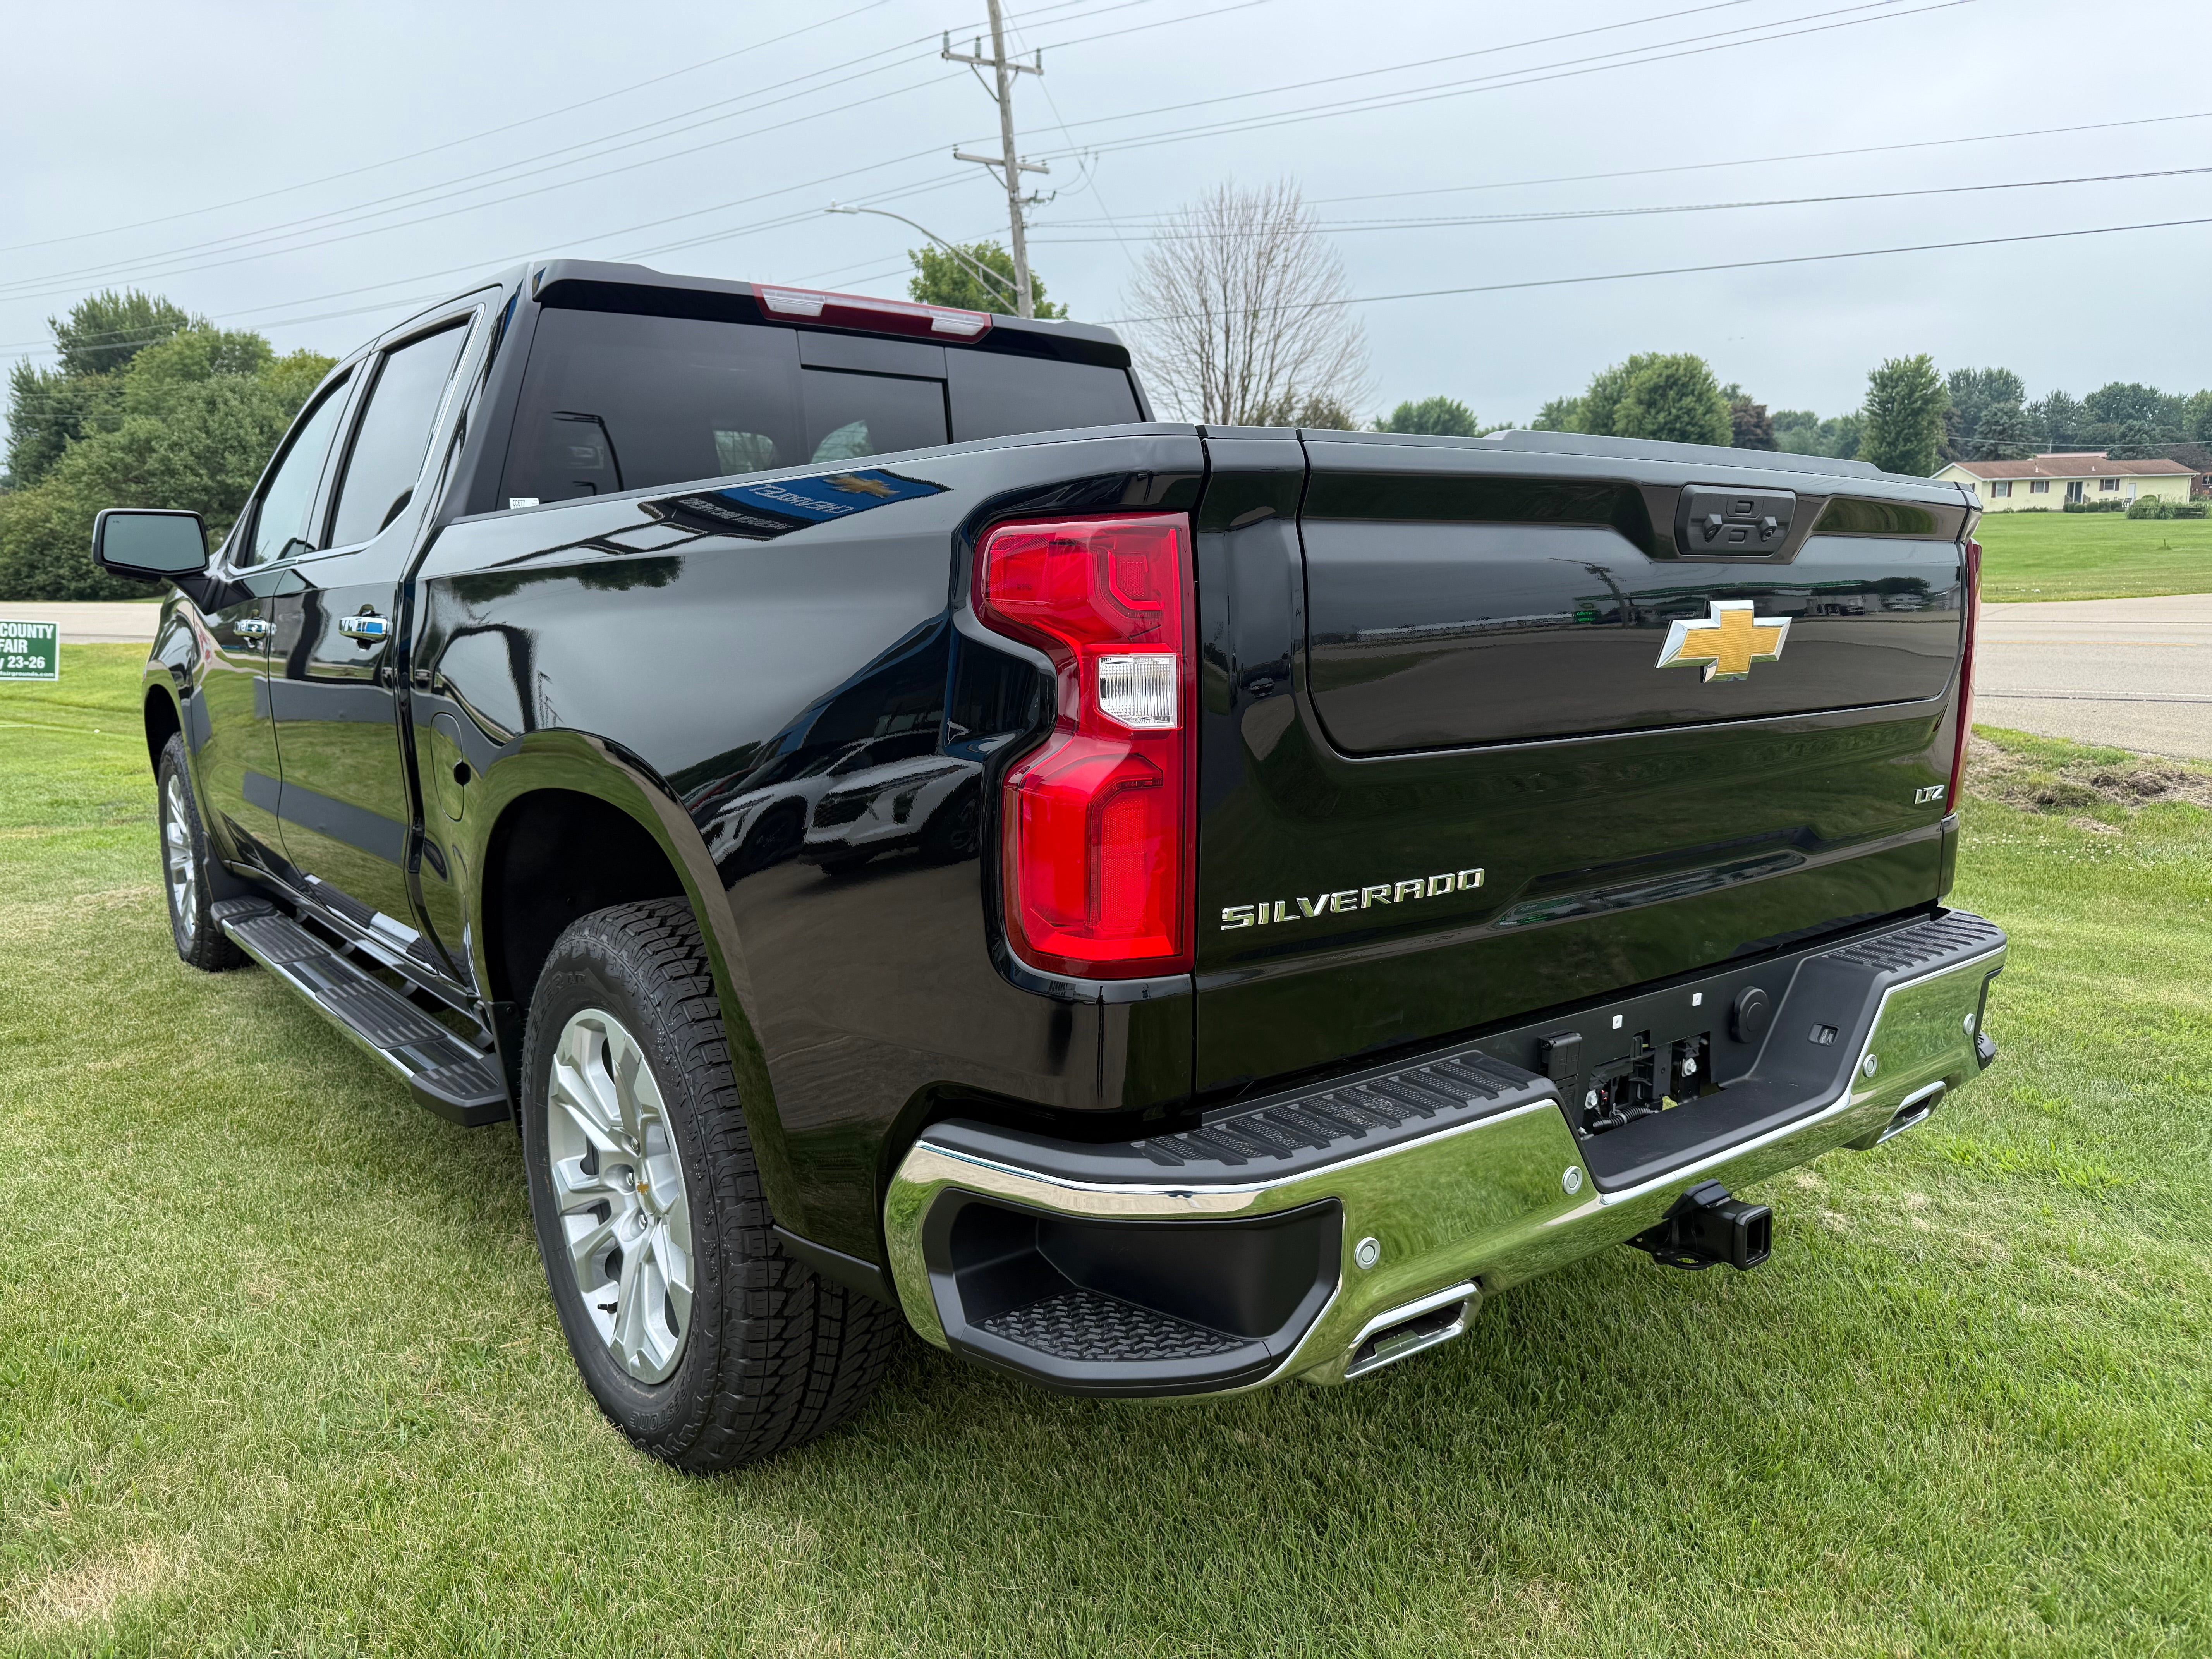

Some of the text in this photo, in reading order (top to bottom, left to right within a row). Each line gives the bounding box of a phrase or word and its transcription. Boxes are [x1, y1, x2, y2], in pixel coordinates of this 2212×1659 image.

[0, 623, 54, 639] COUNTY
[7, 655, 45, 669] 23-26
[1915, 785, 1944, 804] LTZ
[1221, 868, 1485, 930] SILVERADO
